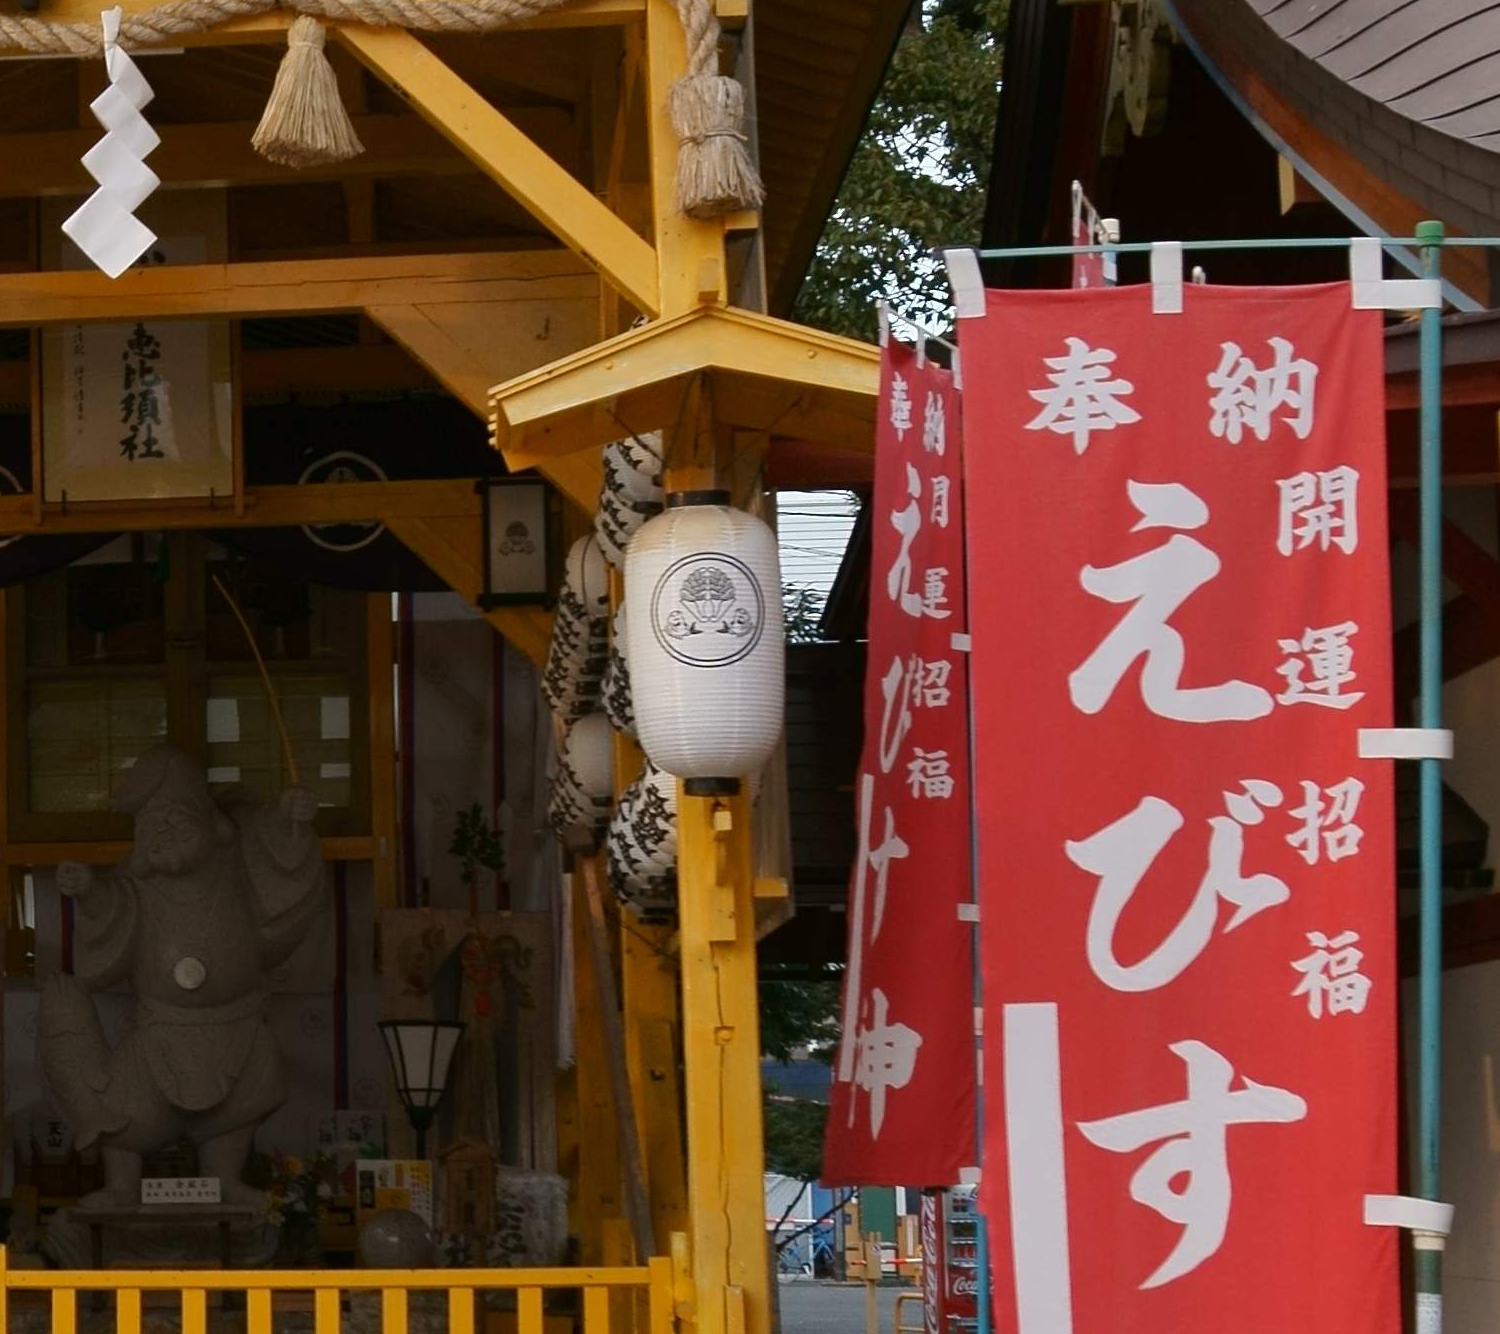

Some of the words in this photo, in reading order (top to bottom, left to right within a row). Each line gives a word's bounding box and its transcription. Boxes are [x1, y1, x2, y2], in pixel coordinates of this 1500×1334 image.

[1025, 337, 1318, 455] 奉納
[1274, 465, 1373, 1019] 開運招福
